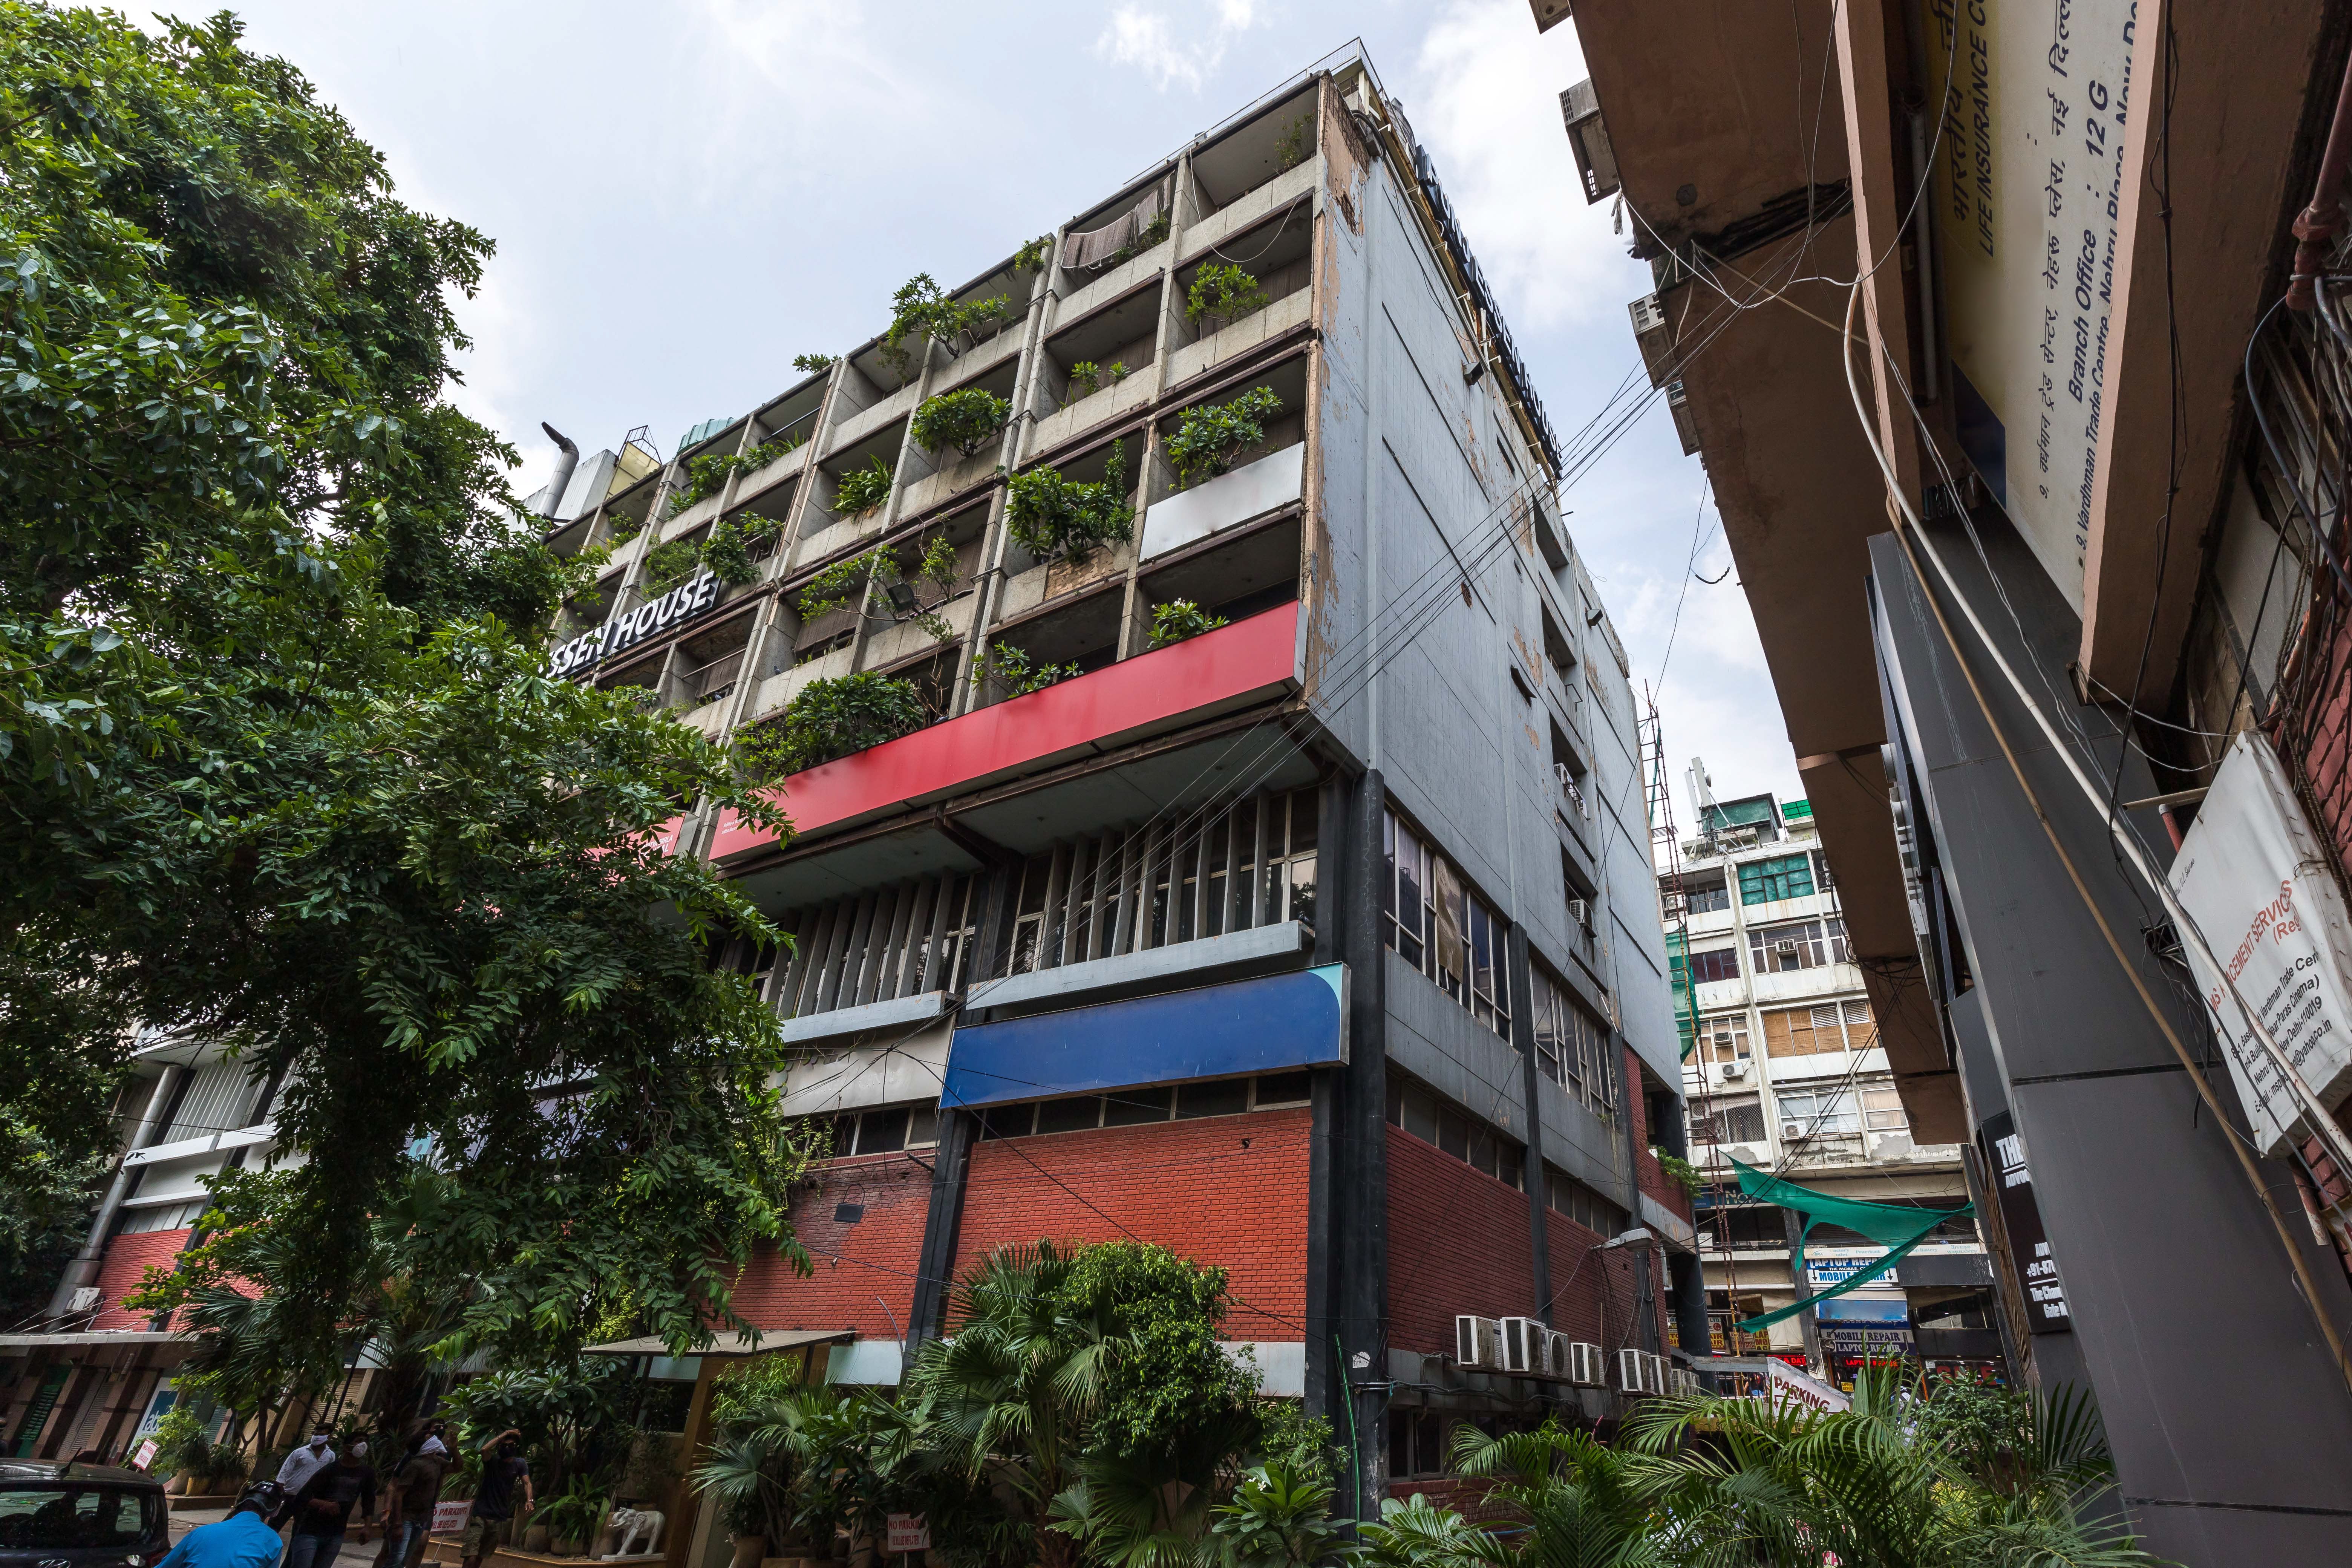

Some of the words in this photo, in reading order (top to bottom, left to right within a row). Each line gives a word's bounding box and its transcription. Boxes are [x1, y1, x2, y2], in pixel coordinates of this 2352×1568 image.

[1967, 0, 1986, 26] C
[1969, 29, 1992, 201] INSURANCE
[2047, 87, 2069, 136] नई
[2089, 80, 2108, 111] G
[2085, 117, 2105, 157] 12
[1978, 197, 1993, 257] LIFE
[2075, 229, 2096, 311] Office
[1474, 255, 1520, 375] ESSEN
[1522, 361, 1563, 470] HOUSE
[2068, 315, 2089, 404] Branch
[2085, 390, 2102, 444] Trade
[2077, 447, 2096, 531] Vardhman
[612, 570, 715, 647] HOUSE
[2219, 931, 2255, 999] PACEMENT
[2261, 984, 2283, 1020] Vardhman
[2279, 966, 2294, 990] Trade
[2276, 1003, 2292, 1026] Paras
[2289, 974, 2320, 1008] Cinema)
[2254, 1063, 2269, 1085] Nehru
[2279, 1035, 2290, 1053] New
[2287, 996, 2322, 1042] Delhi-110019
[1995, 1133, 2024, 1168] THE
[1809, 1258, 1849, 1269] LAPTOP
[1851, 1257, 1879, 1266] REPA
[1834, 1331, 1866, 1341] MOBIL
[1868, 1332, 1901, 1341] REPAIR
[1774, 1375, 1831, 1413] PARKING
[438, 1506, 468, 1516] PARKING
[889, 1520, 897, 1530] NO
[899, 1519, 926, 1530] PARKIN
